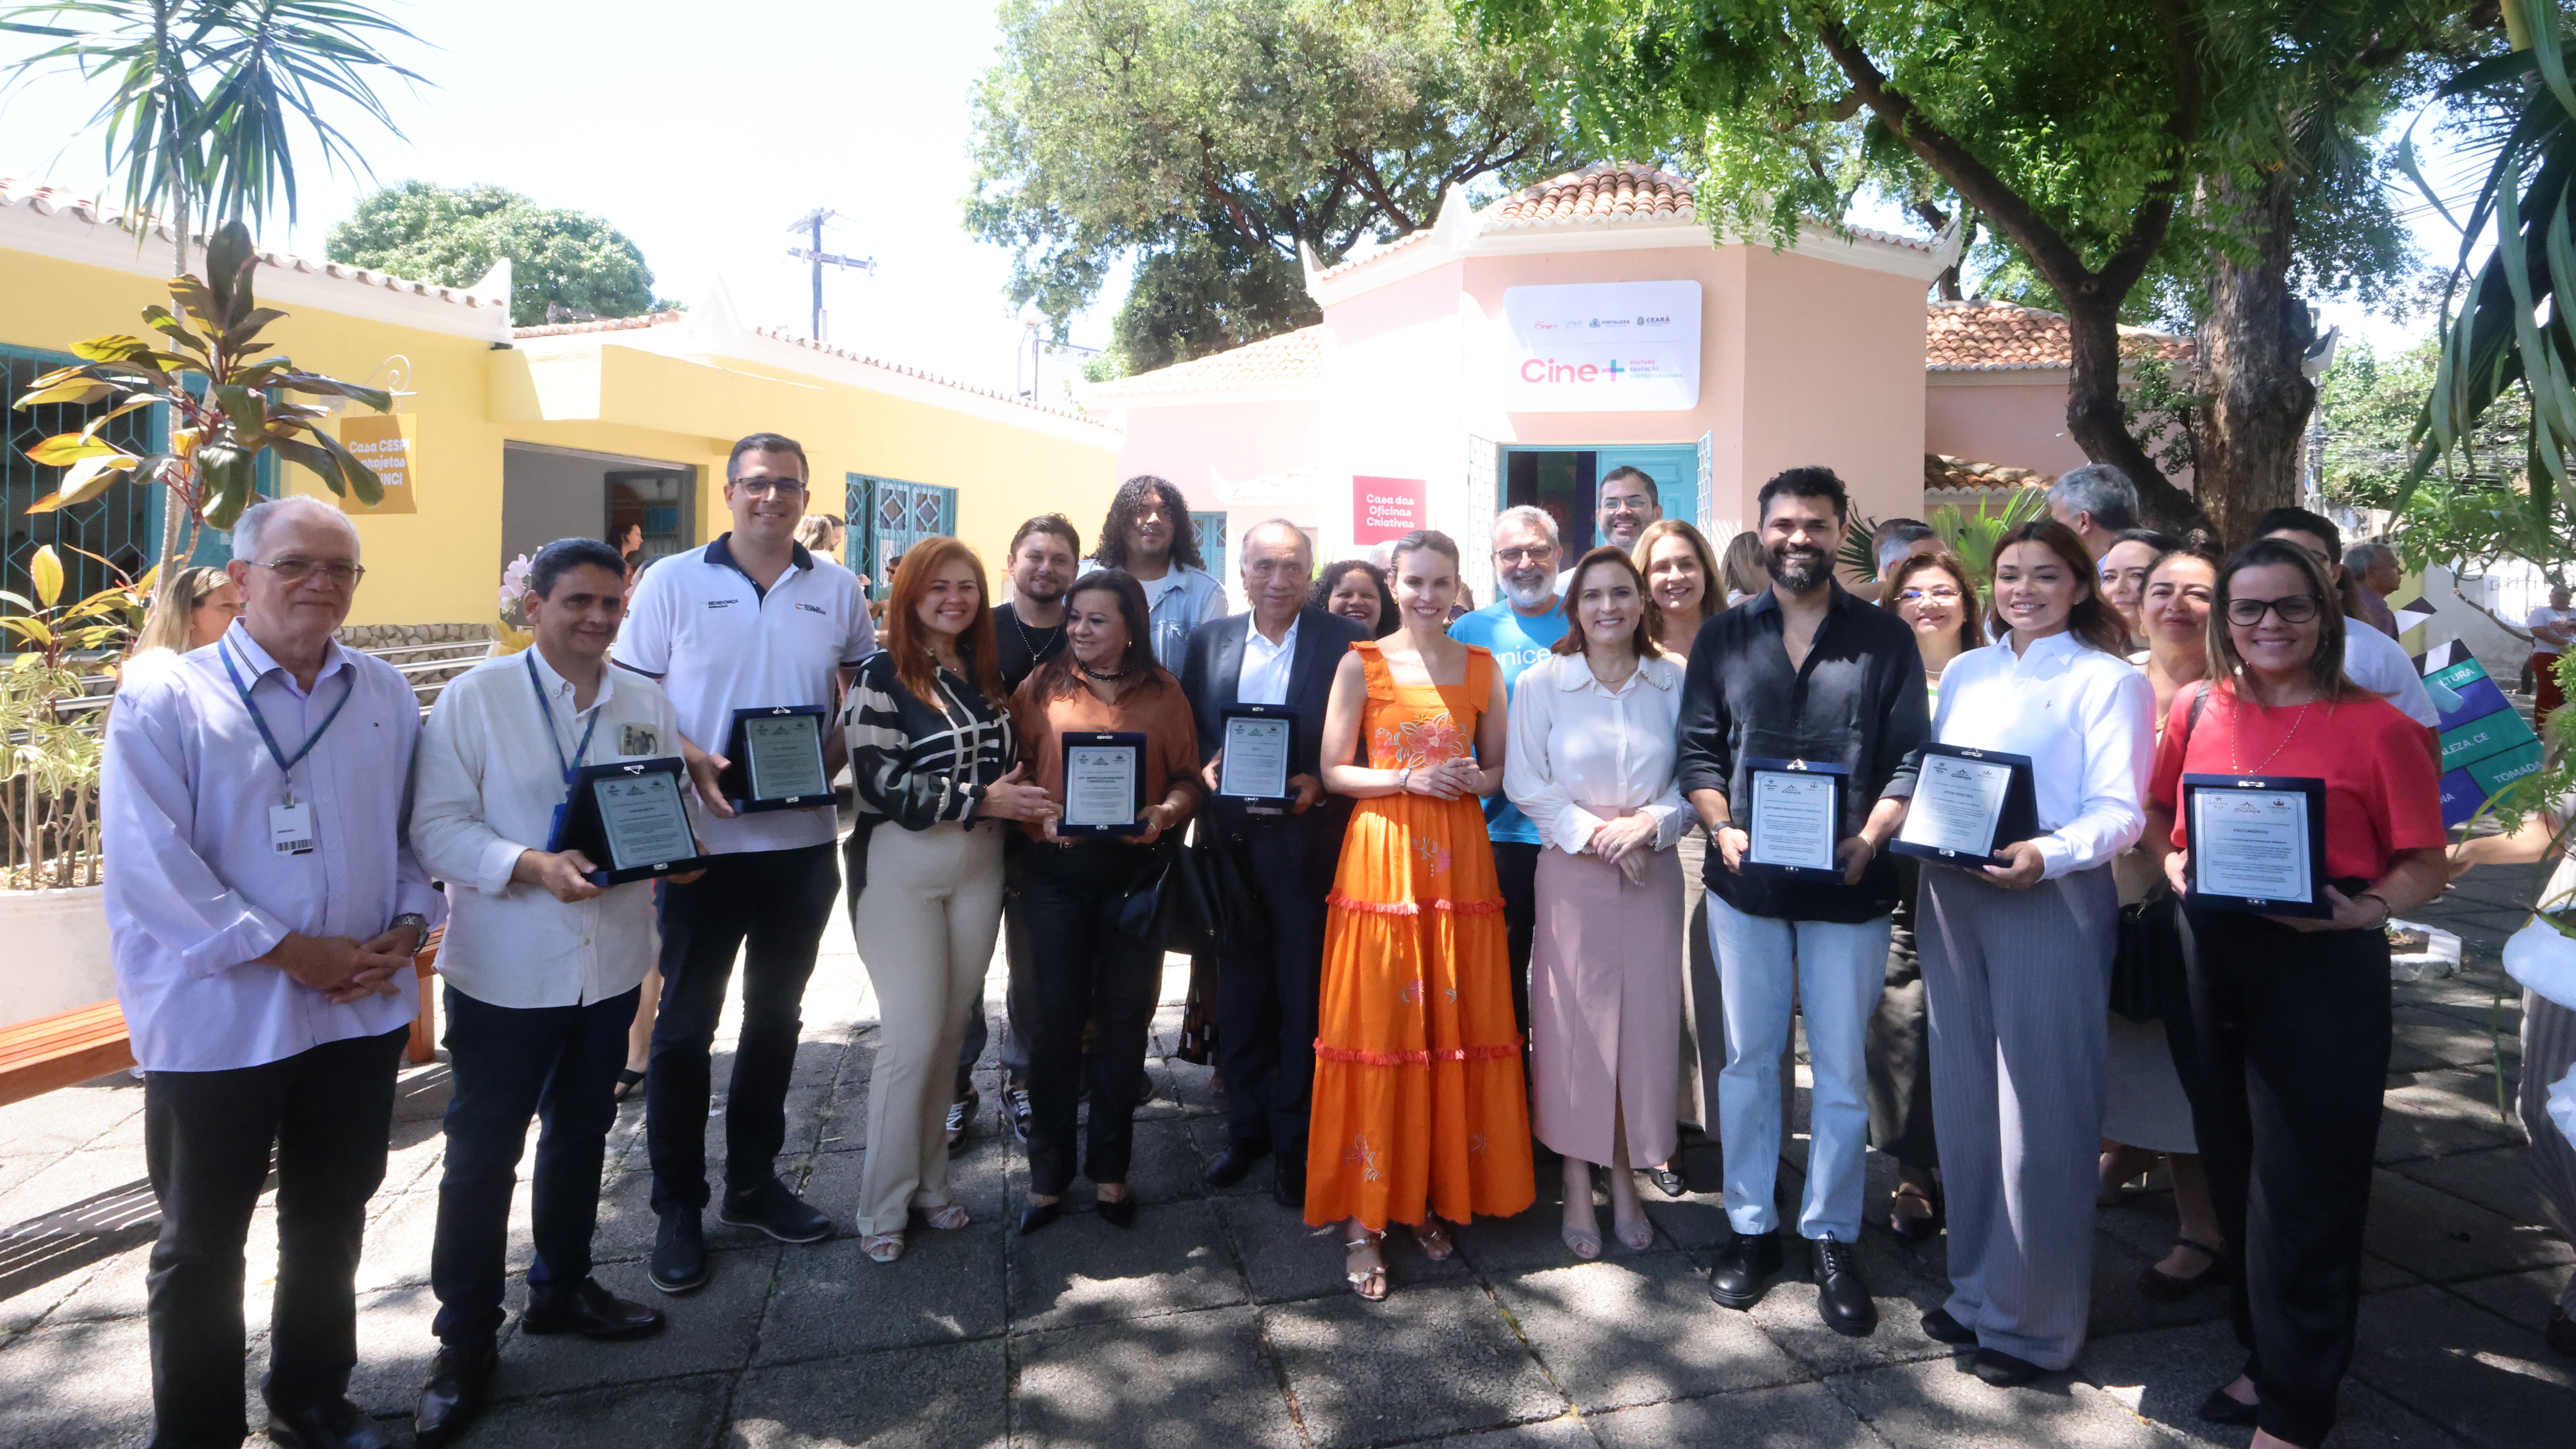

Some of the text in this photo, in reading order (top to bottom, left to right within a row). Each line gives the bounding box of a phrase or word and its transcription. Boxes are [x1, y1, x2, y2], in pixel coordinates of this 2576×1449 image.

[349, 438, 409, 453] Casa CESPI
[1366, 494, 1414, 506] Casa das
[1369, 505, 1412, 517] Oficinas
[1366, 517, 1414, 528] Criativas
[2439, 668, 2475, 686] LTURA
[2474, 732, 2490, 743] CE
[2493, 761, 2543, 783] TOMADA
